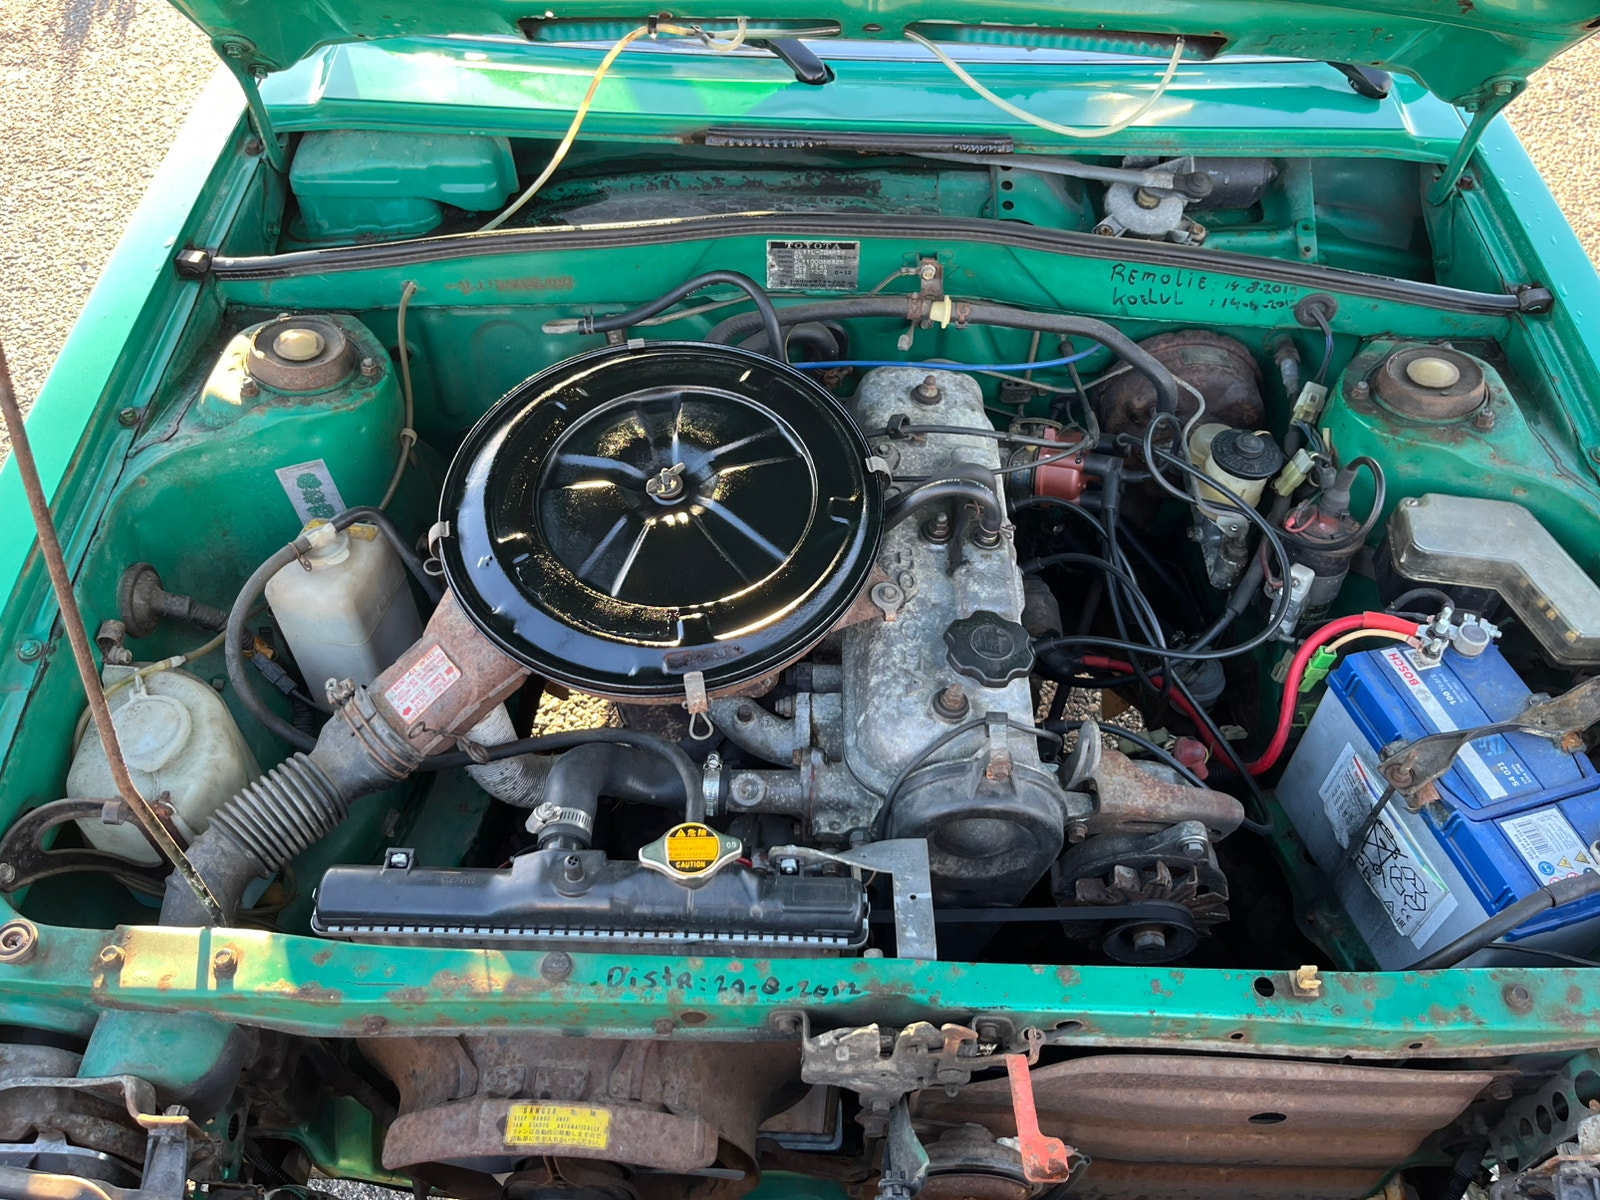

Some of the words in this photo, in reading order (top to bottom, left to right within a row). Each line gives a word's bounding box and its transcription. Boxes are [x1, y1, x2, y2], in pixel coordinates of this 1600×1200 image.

[1388, 653, 1420, 686] BOSCH
[1430, 674, 1446, 692] Years
[1442, 691, 1456, 706] 100
[1497, 761, 1511, 775] 021
[1508, 776, 1520, 787] S4
[557, 1123, 600, 1131] AUTOMATICALLY
